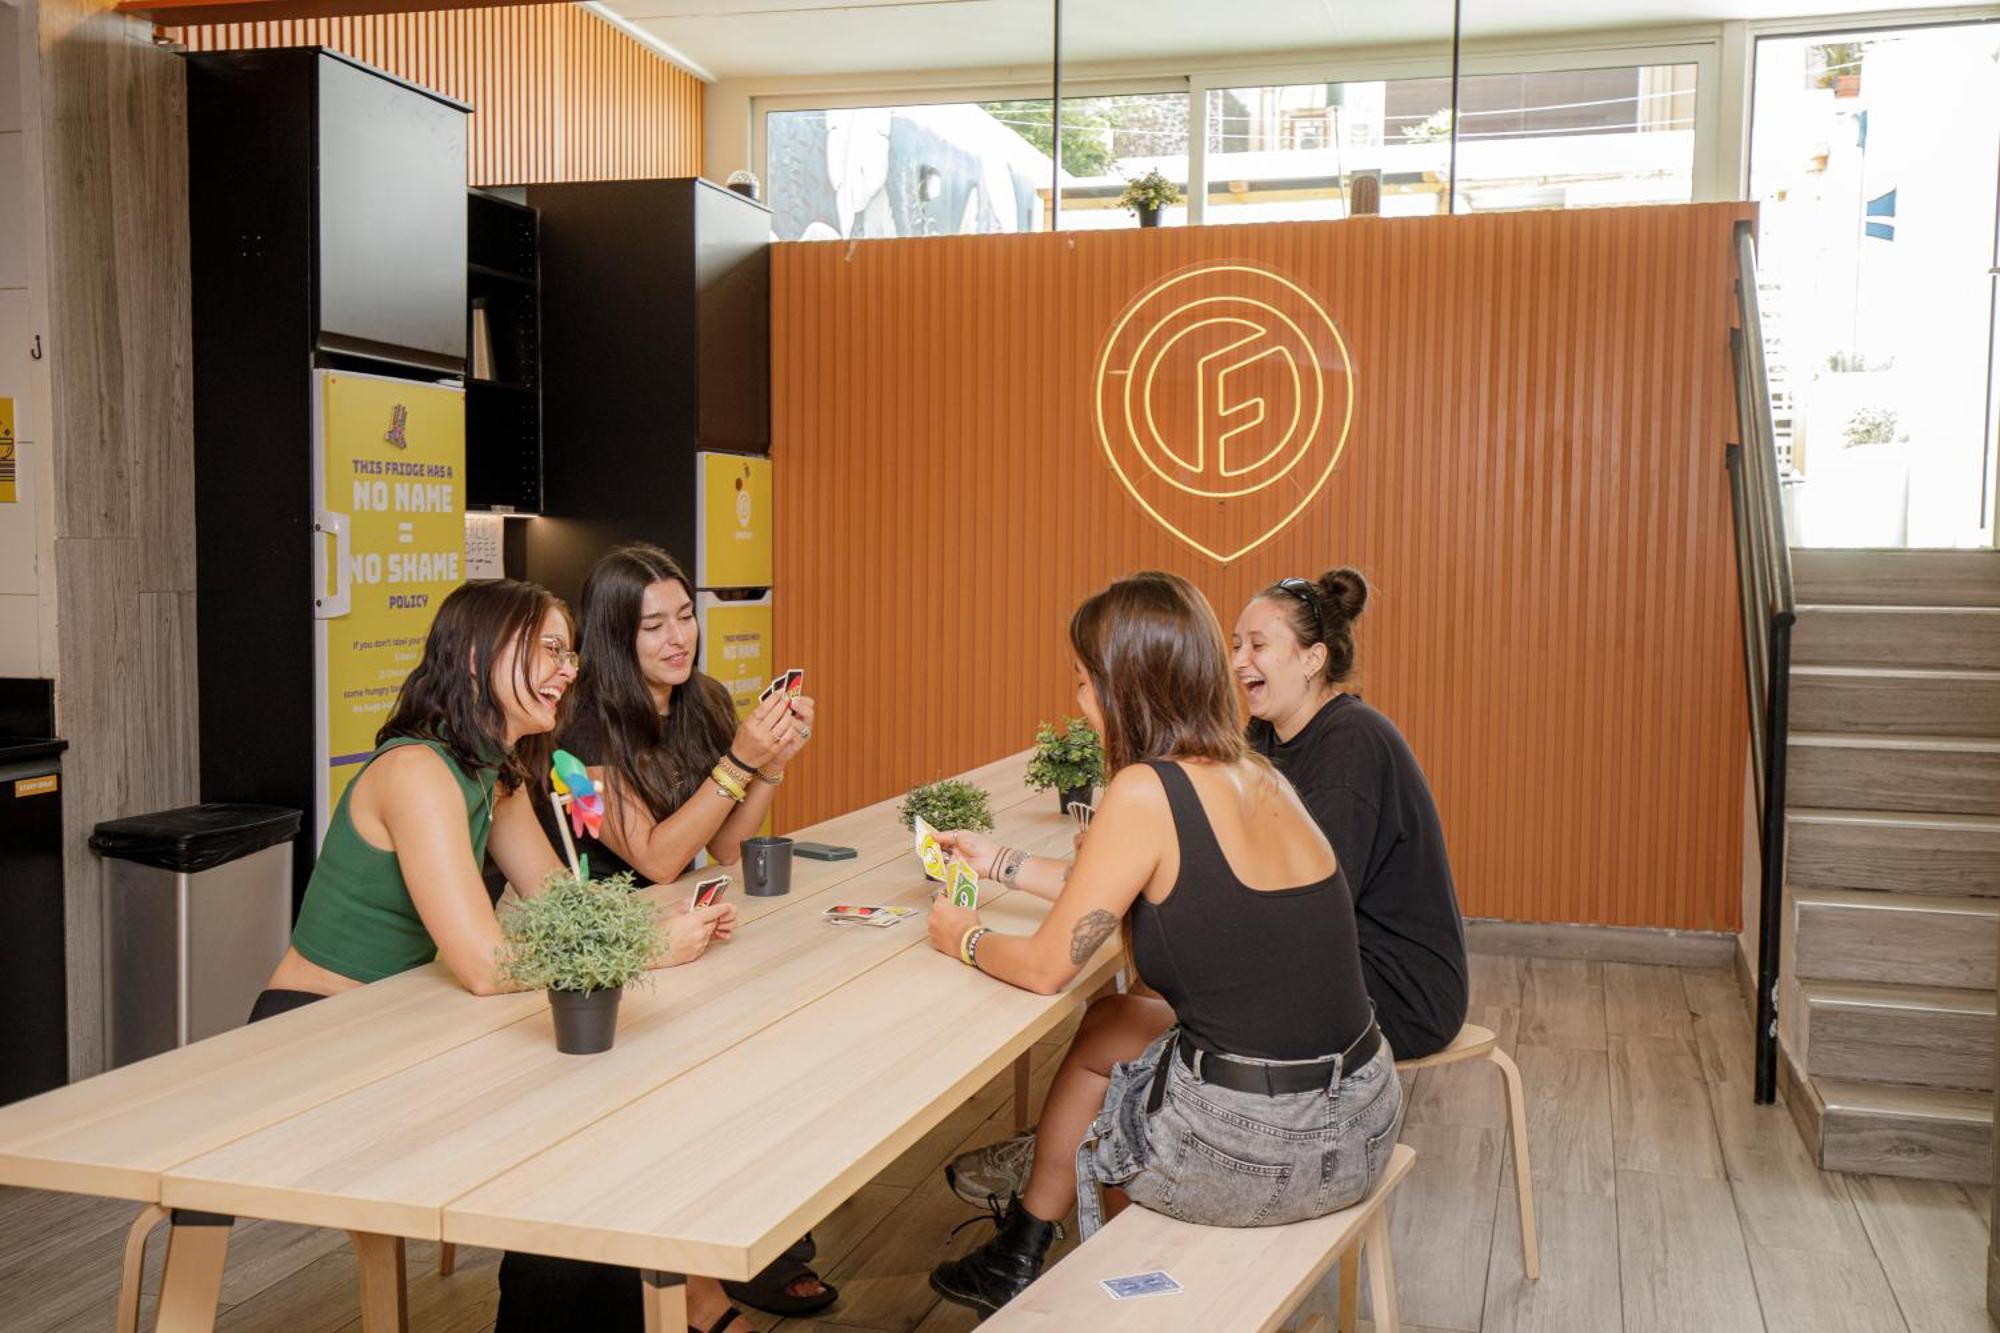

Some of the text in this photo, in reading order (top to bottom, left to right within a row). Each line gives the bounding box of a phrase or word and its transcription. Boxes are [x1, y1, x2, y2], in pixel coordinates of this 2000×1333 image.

[352, 460, 453, 478] THIS FRIDGE HAS A
[353, 480, 453, 513] NO NAME
[388, 552, 458, 583] SHAME
[389, 594, 429, 609] POLICY
[360, 641, 373, 651] you
[344, 690, 363, 699] some
[365, 687, 389, 698] hungry
